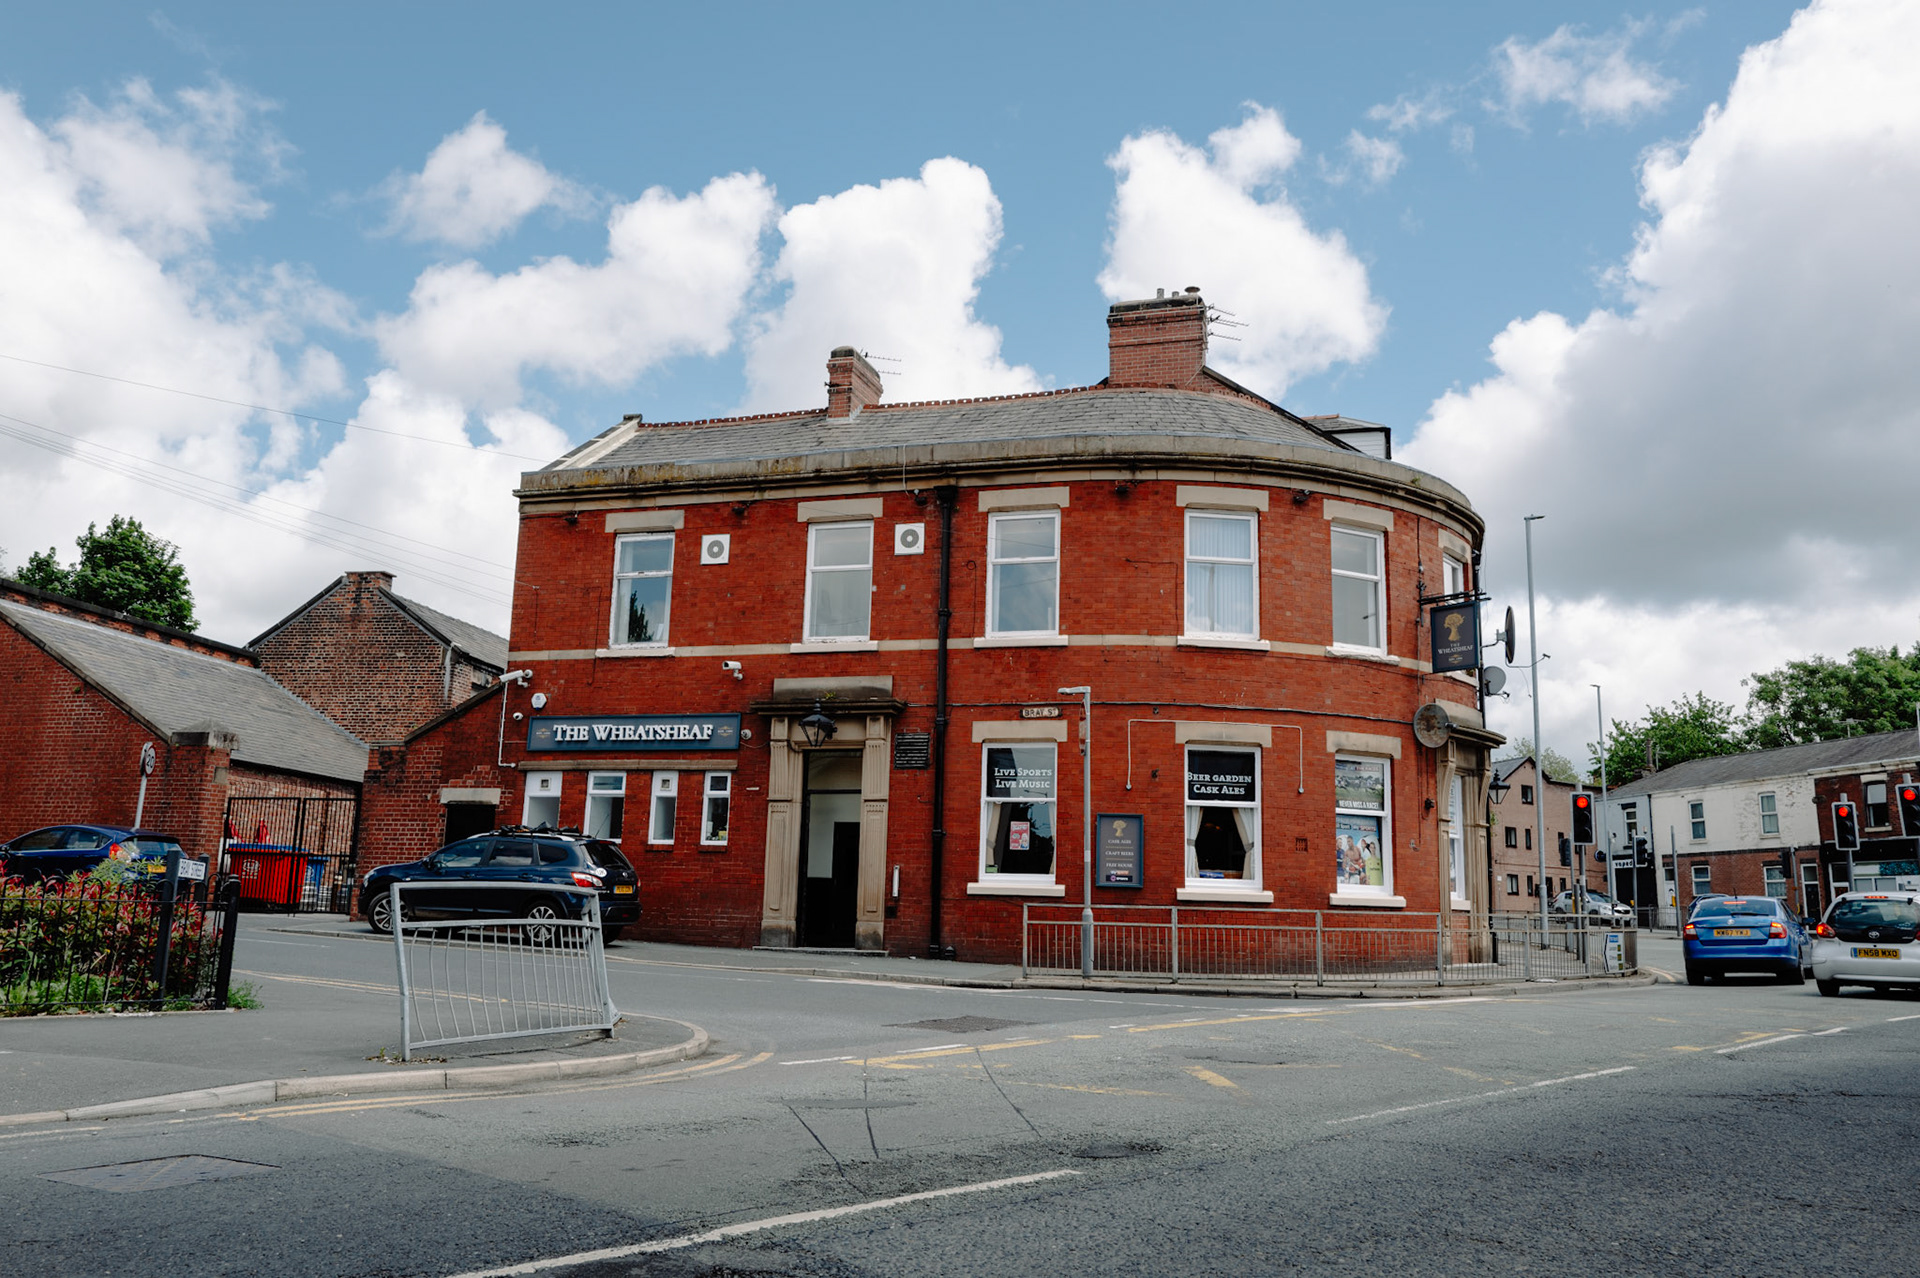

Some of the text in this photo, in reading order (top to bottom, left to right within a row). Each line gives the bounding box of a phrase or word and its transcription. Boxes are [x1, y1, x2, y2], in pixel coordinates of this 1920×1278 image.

[1437, 644, 1474, 655] WHEATSHEAF
[1024, 708, 1045, 717] BRAY
[553, 723, 714, 742] THE WHEATSHEAF
[146, 753, 155, 769] 20
[994, 767, 1052, 776] LIVE SPORTS
[1188, 771, 1252, 783] BEER GARDEN
[995, 779, 1051, 788] LIVE MUSIC
[1193, 784, 1245, 795] CASK ALES
[1858, 949, 1879, 957] FN58
